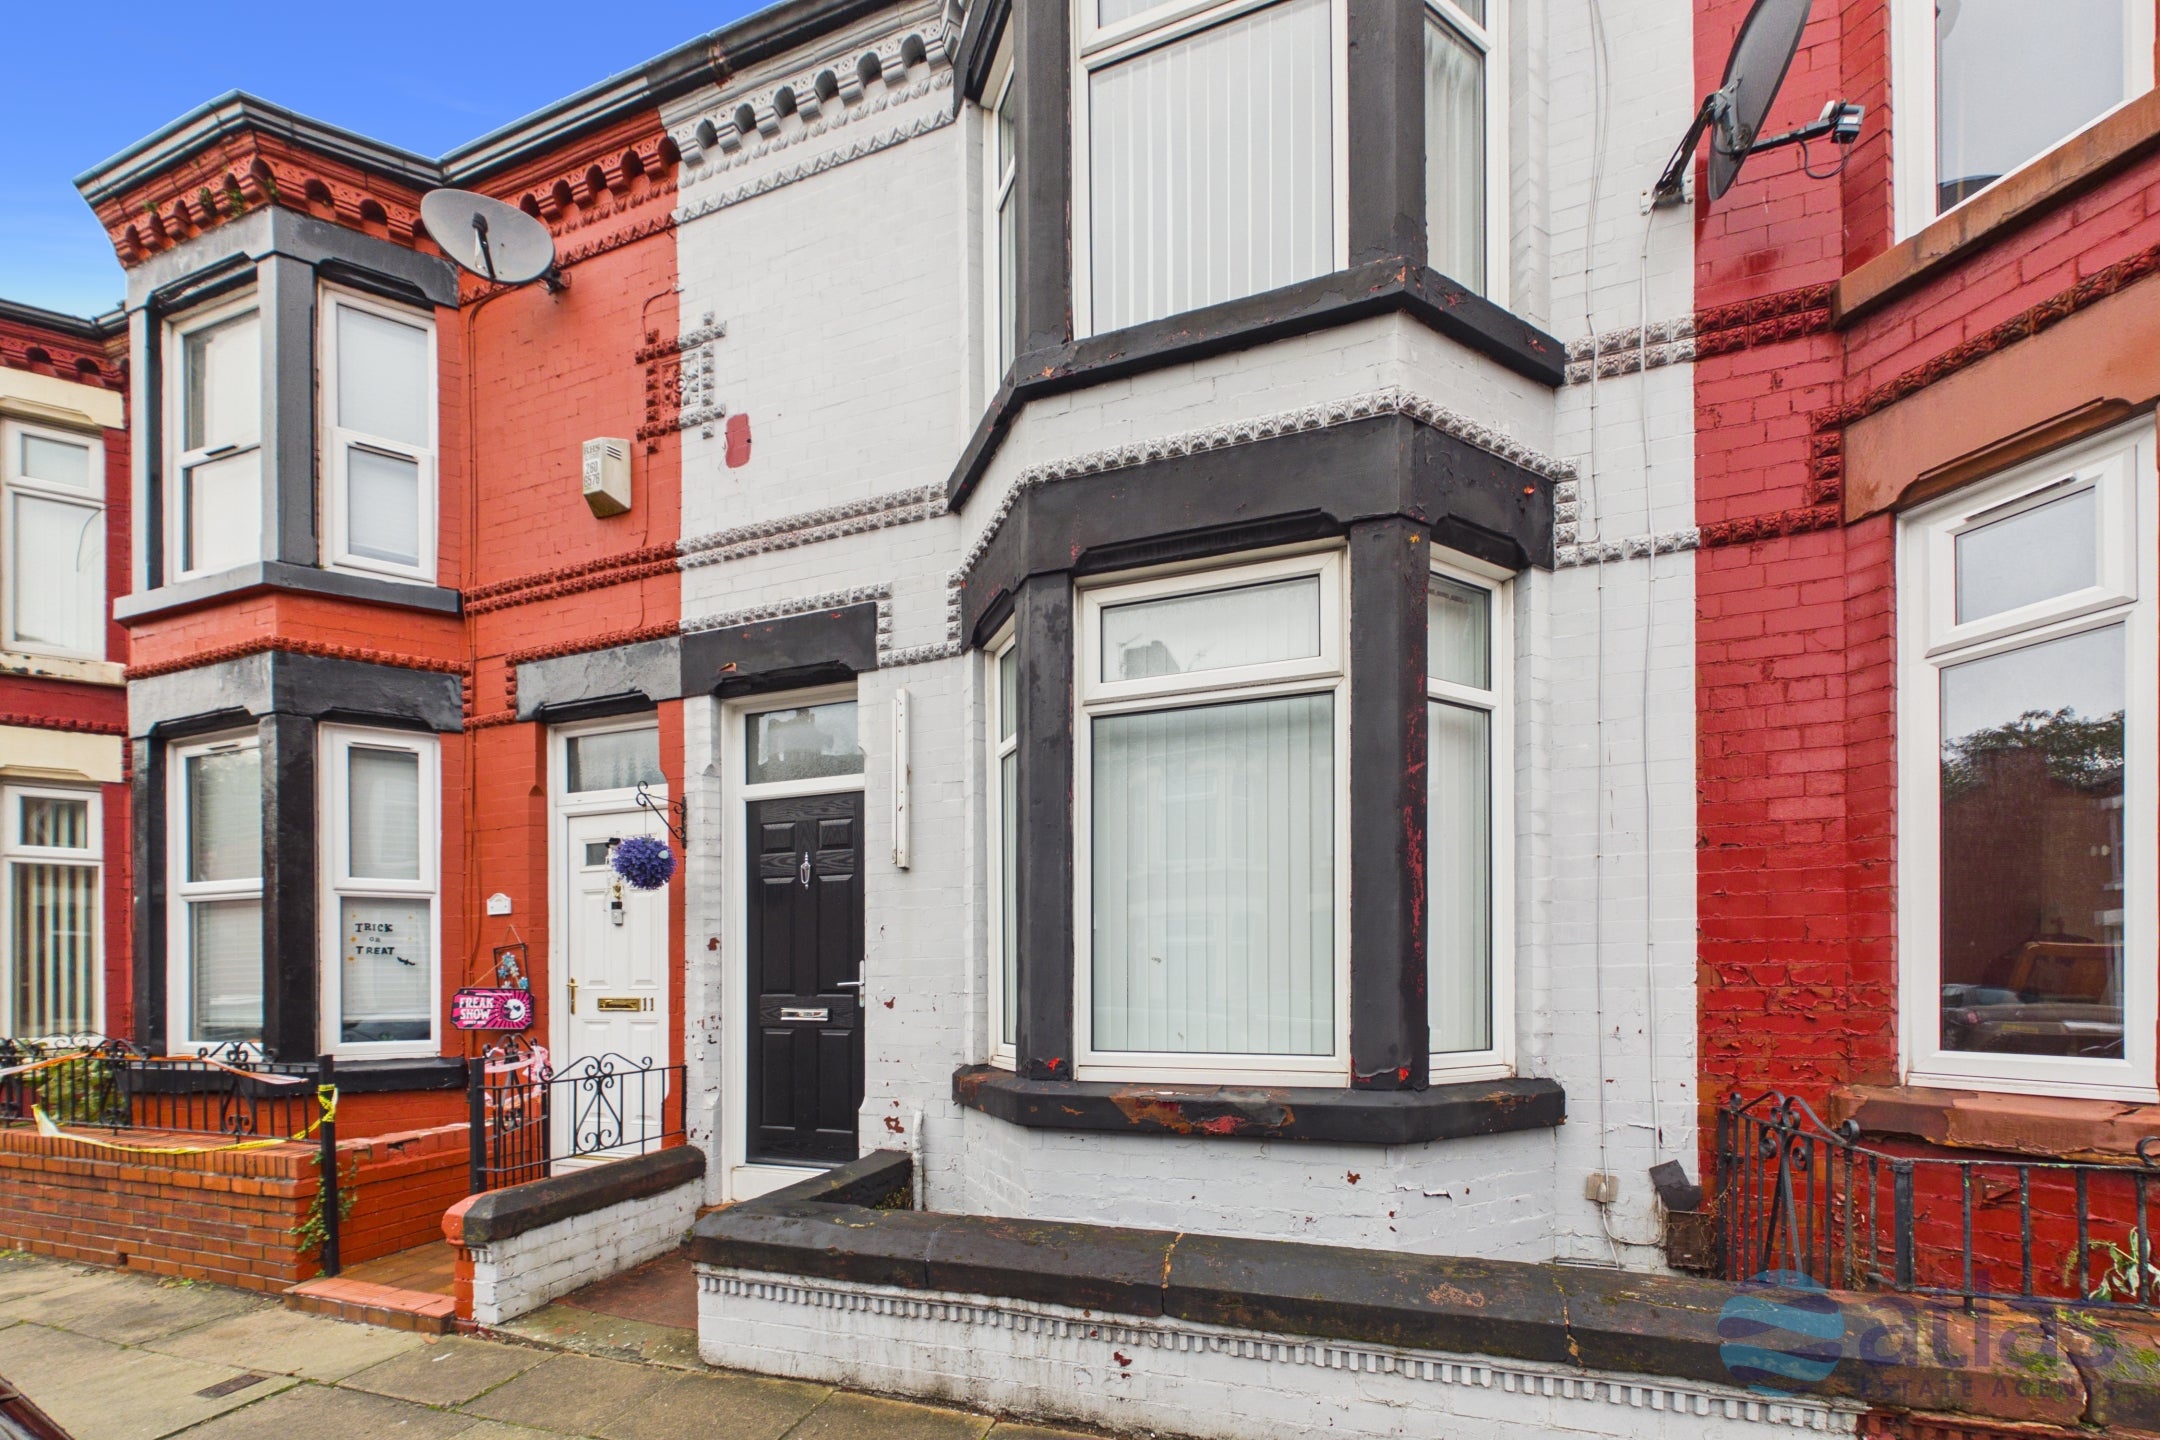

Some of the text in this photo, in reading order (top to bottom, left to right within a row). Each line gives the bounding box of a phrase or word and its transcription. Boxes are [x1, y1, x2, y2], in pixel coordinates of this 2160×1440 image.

[355, 922, 393, 932] TRICK
[356, 946, 395, 955] TREAT
[460, 997, 495, 1008] FREAK
[643, 997, 654, 1011] 11
[460, 1008, 491, 1019] SHOW
